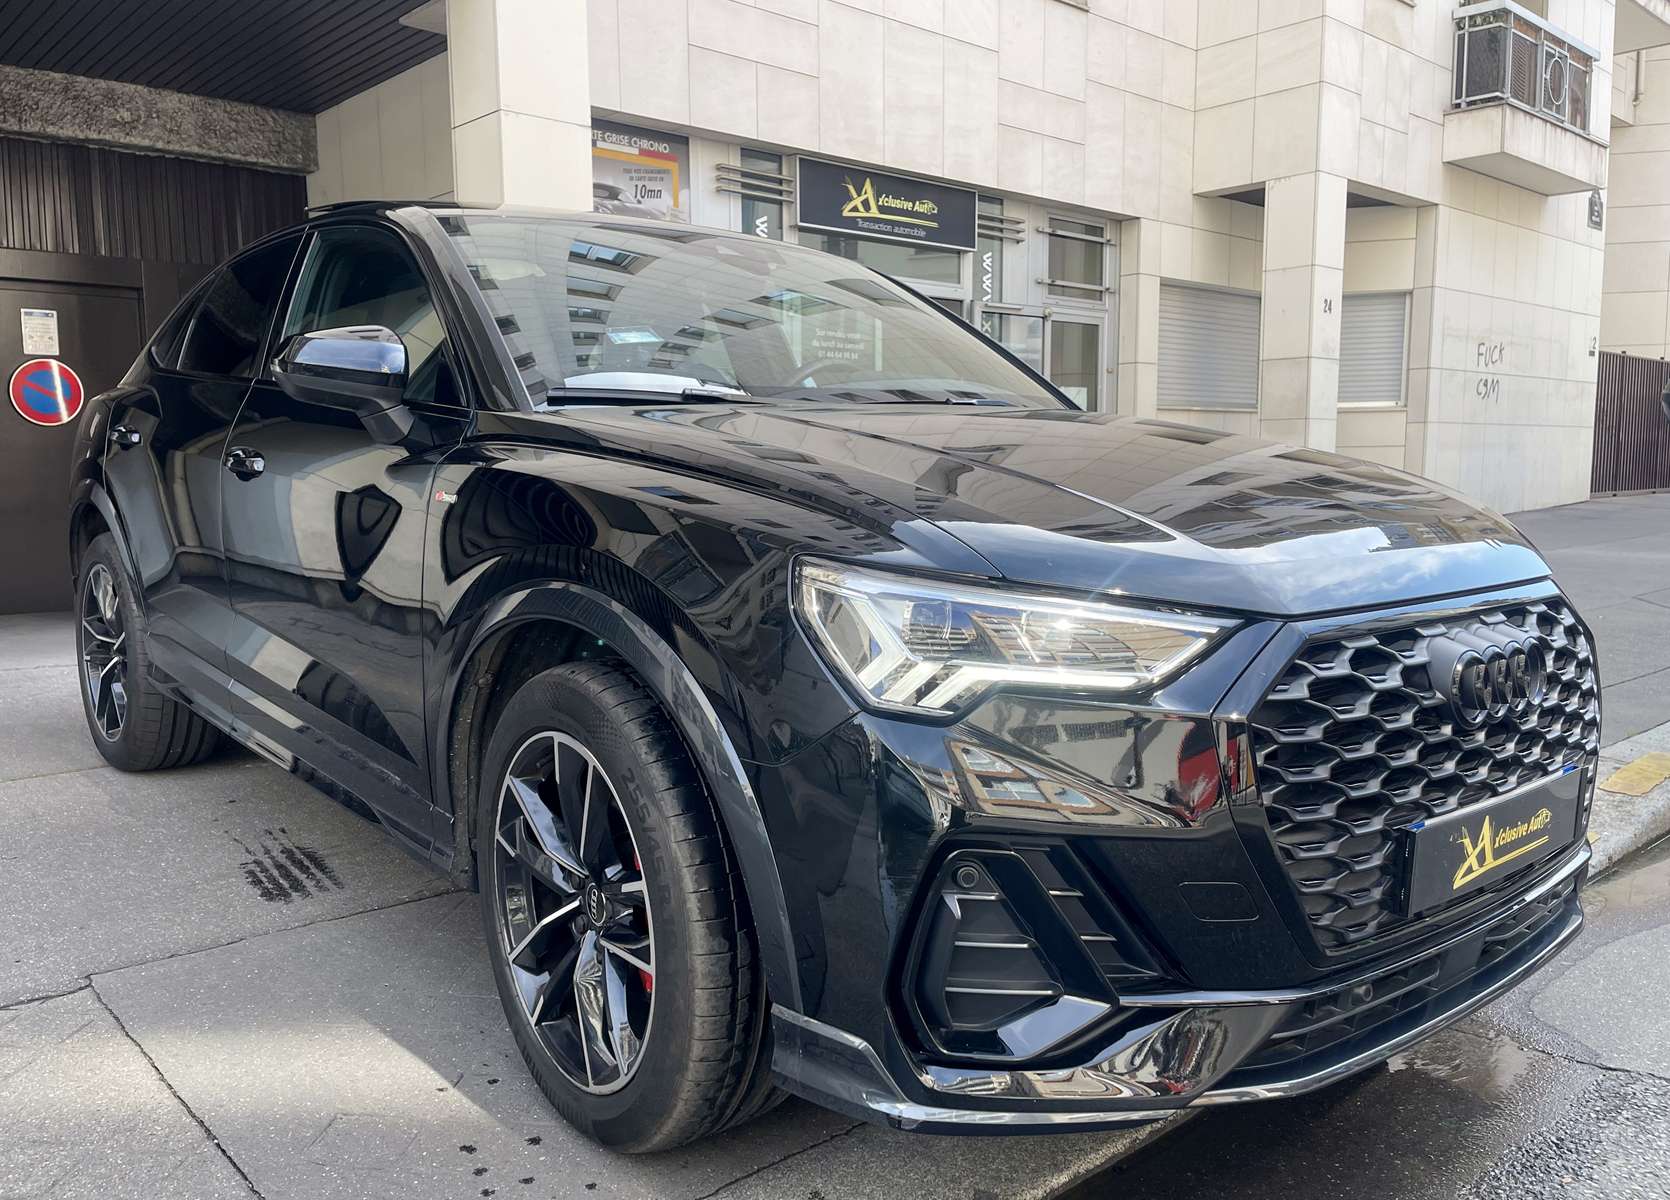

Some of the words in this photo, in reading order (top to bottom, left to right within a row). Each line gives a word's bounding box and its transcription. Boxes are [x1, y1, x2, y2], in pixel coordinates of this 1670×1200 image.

[604, 132, 630, 146] GRISE
[631, 137, 670, 154] CHRONO
[634, 184, 662, 200] 10mn
[1323, 298, 1332, 314] 24
